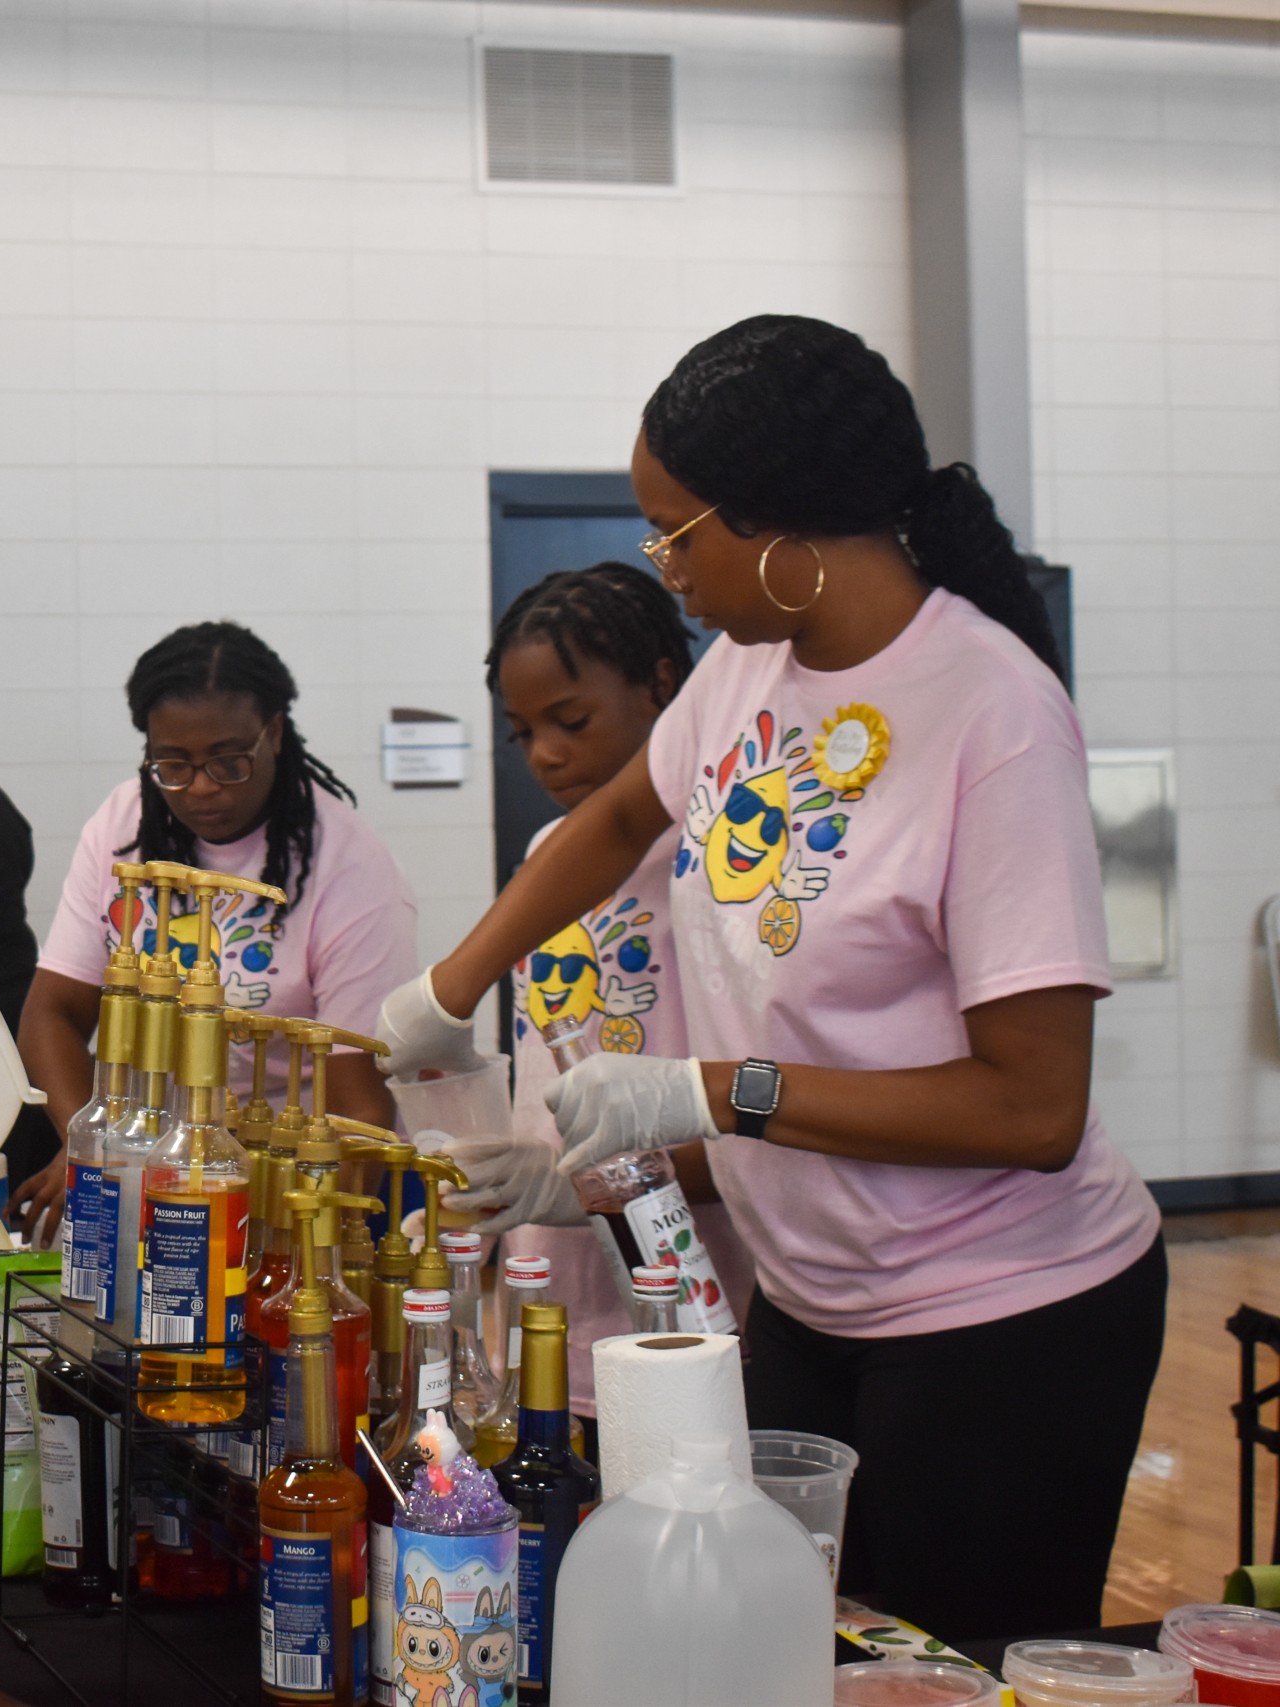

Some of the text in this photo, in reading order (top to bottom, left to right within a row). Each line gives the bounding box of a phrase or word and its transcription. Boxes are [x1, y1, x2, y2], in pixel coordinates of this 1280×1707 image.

[154, 1207, 207, 1219] PASSION FRUIT
[518, 1538, 542, 1547] BERRY
[283, 1544, 316, 1556] MANGO
